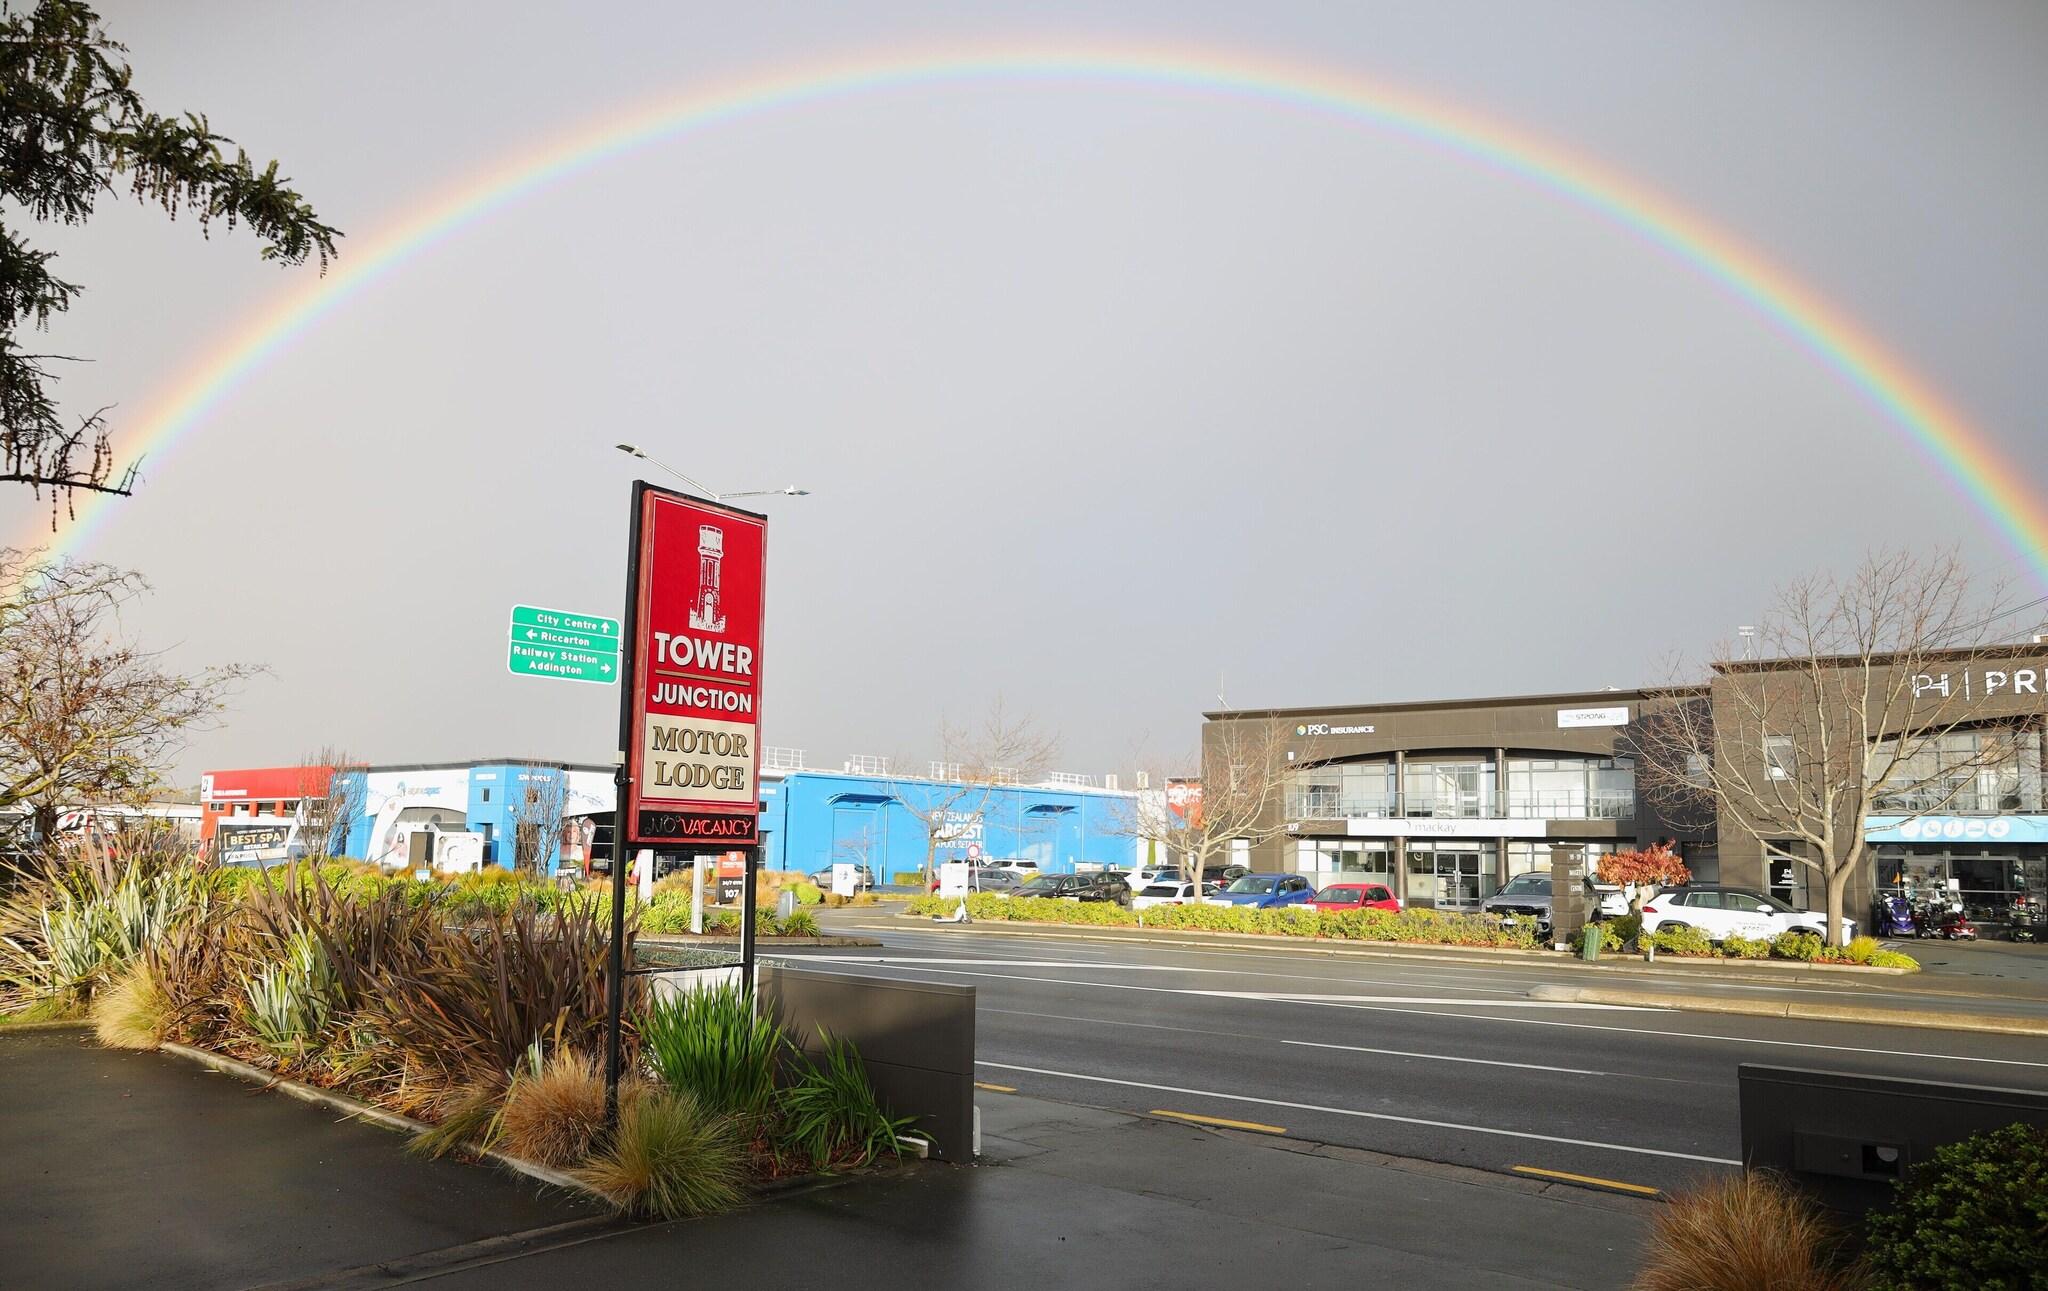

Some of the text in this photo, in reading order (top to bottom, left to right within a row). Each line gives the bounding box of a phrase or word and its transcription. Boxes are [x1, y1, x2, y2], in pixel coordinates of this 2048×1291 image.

[537, 613, 597, 630] City Centre
[541, 631, 590, 646] Riccarton
[513, 645, 598, 664] Railway Station
[654, 632, 753, 675] TOWER
[529, 660, 582, 675] Addington
[652, 682, 752, 713] JUNCTION
[1307, 723, 1375, 736] PSC INSURANCE
[652, 725, 749, 758] MOTOR
[654, 760, 745, 790] LODGE
[644, 815, 752, 836] NO VACANCY
[1415, 822, 1456, 834] mackay
[230, 832, 281, 845] BEST SPA
[724, 889, 739, 898] 107
